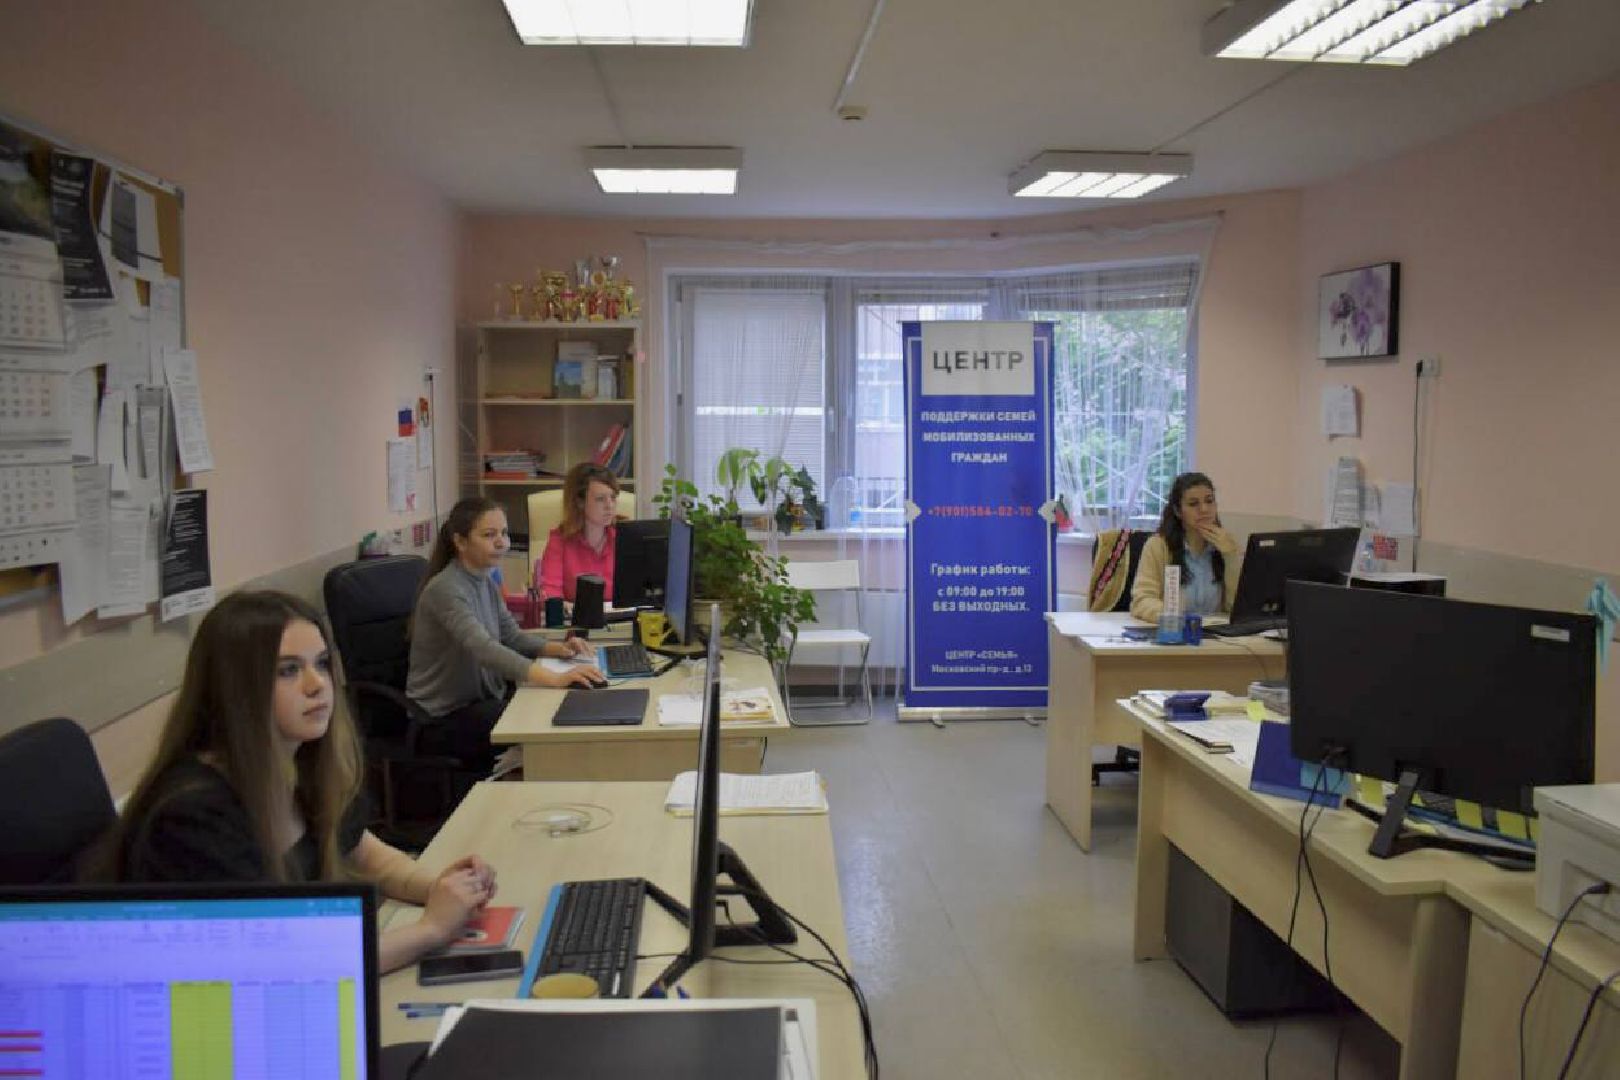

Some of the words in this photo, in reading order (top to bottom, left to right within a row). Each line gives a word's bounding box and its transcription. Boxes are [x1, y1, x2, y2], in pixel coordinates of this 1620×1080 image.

[933, 350, 1024, 373] ЦЕНТР
[921, 411, 995, 423] ПОДДЕРЖКИ
[997, 410, 1036, 421] СЕМЕЙ
[923, 432, 1035, 442] МОБИЛИЗОВАННЫХ
[951, 452, 1008, 463] ГРАЖДАН
[931, 563, 978, 576] График
[980, 563, 1031, 576] работы:
[946, 585, 977, 596] 09:00
[979, 588, 994, 598] до
[996, 585, 1025, 596] 19:00
[932, 601, 956, 612] БЕЗ
[958, 601, 1031, 613] ВЫХОДНЫХ.
[945, 650, 976, 660] ЦЕНТР
[931, 663, 986, 673] Московский
